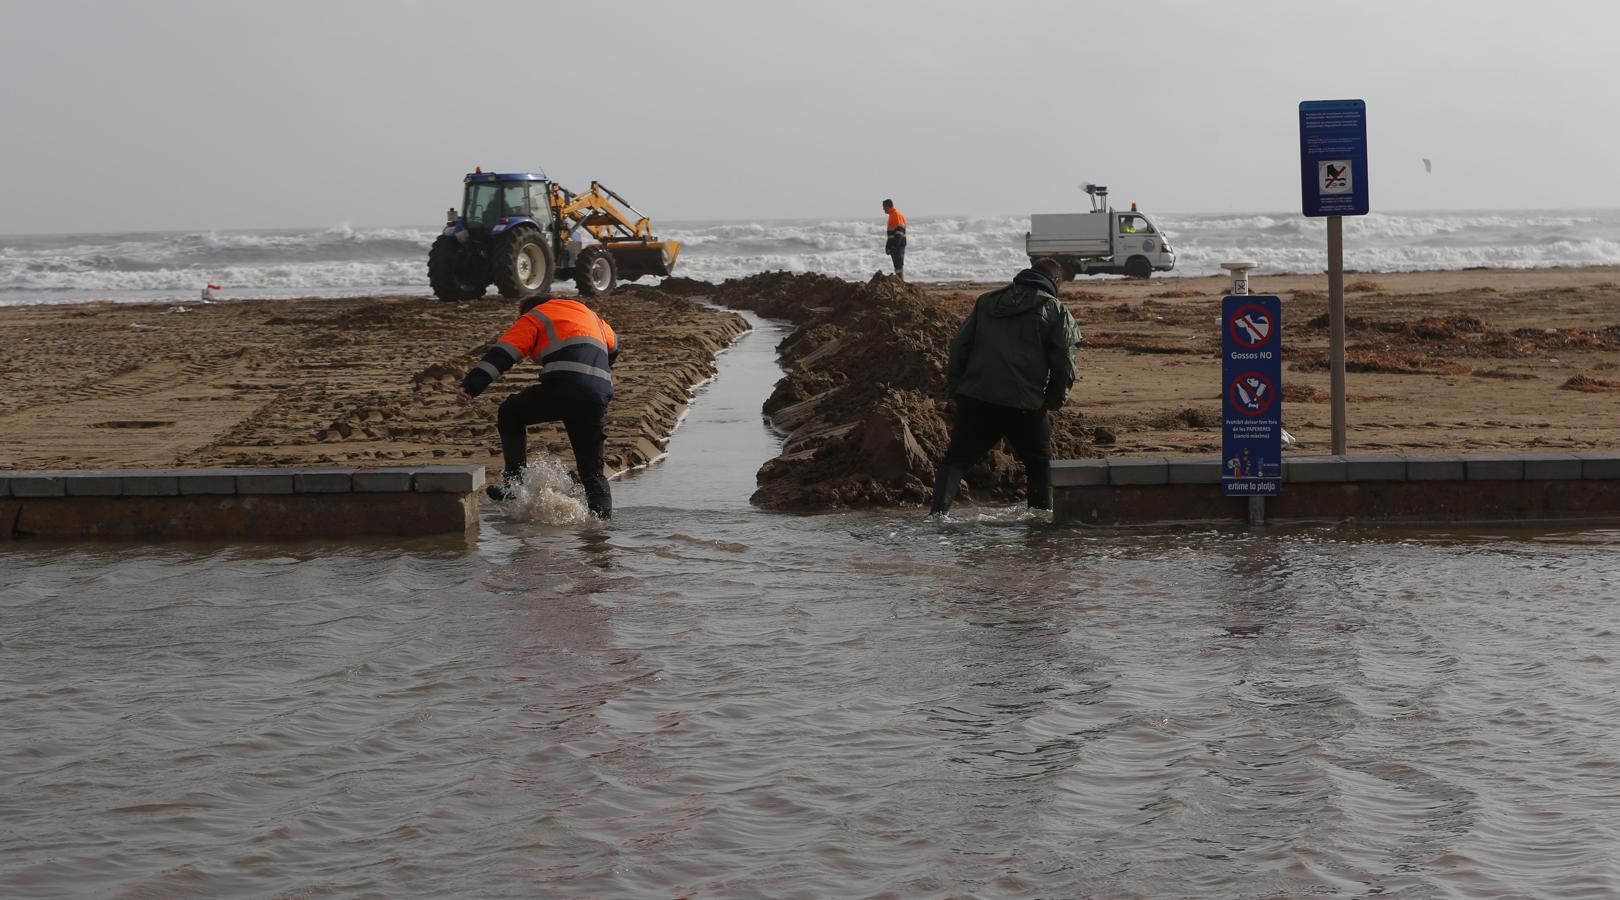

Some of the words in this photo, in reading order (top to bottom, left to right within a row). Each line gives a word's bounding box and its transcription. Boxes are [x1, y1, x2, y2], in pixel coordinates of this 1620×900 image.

[1231, 351, 1258, 360] Gossos
[1259, 351, 1272, 360] NO
[1227, 481, 1249, 490] estime
[1249, 481, 1257, 490] la
[1257, 481, 1276, 492] platja
